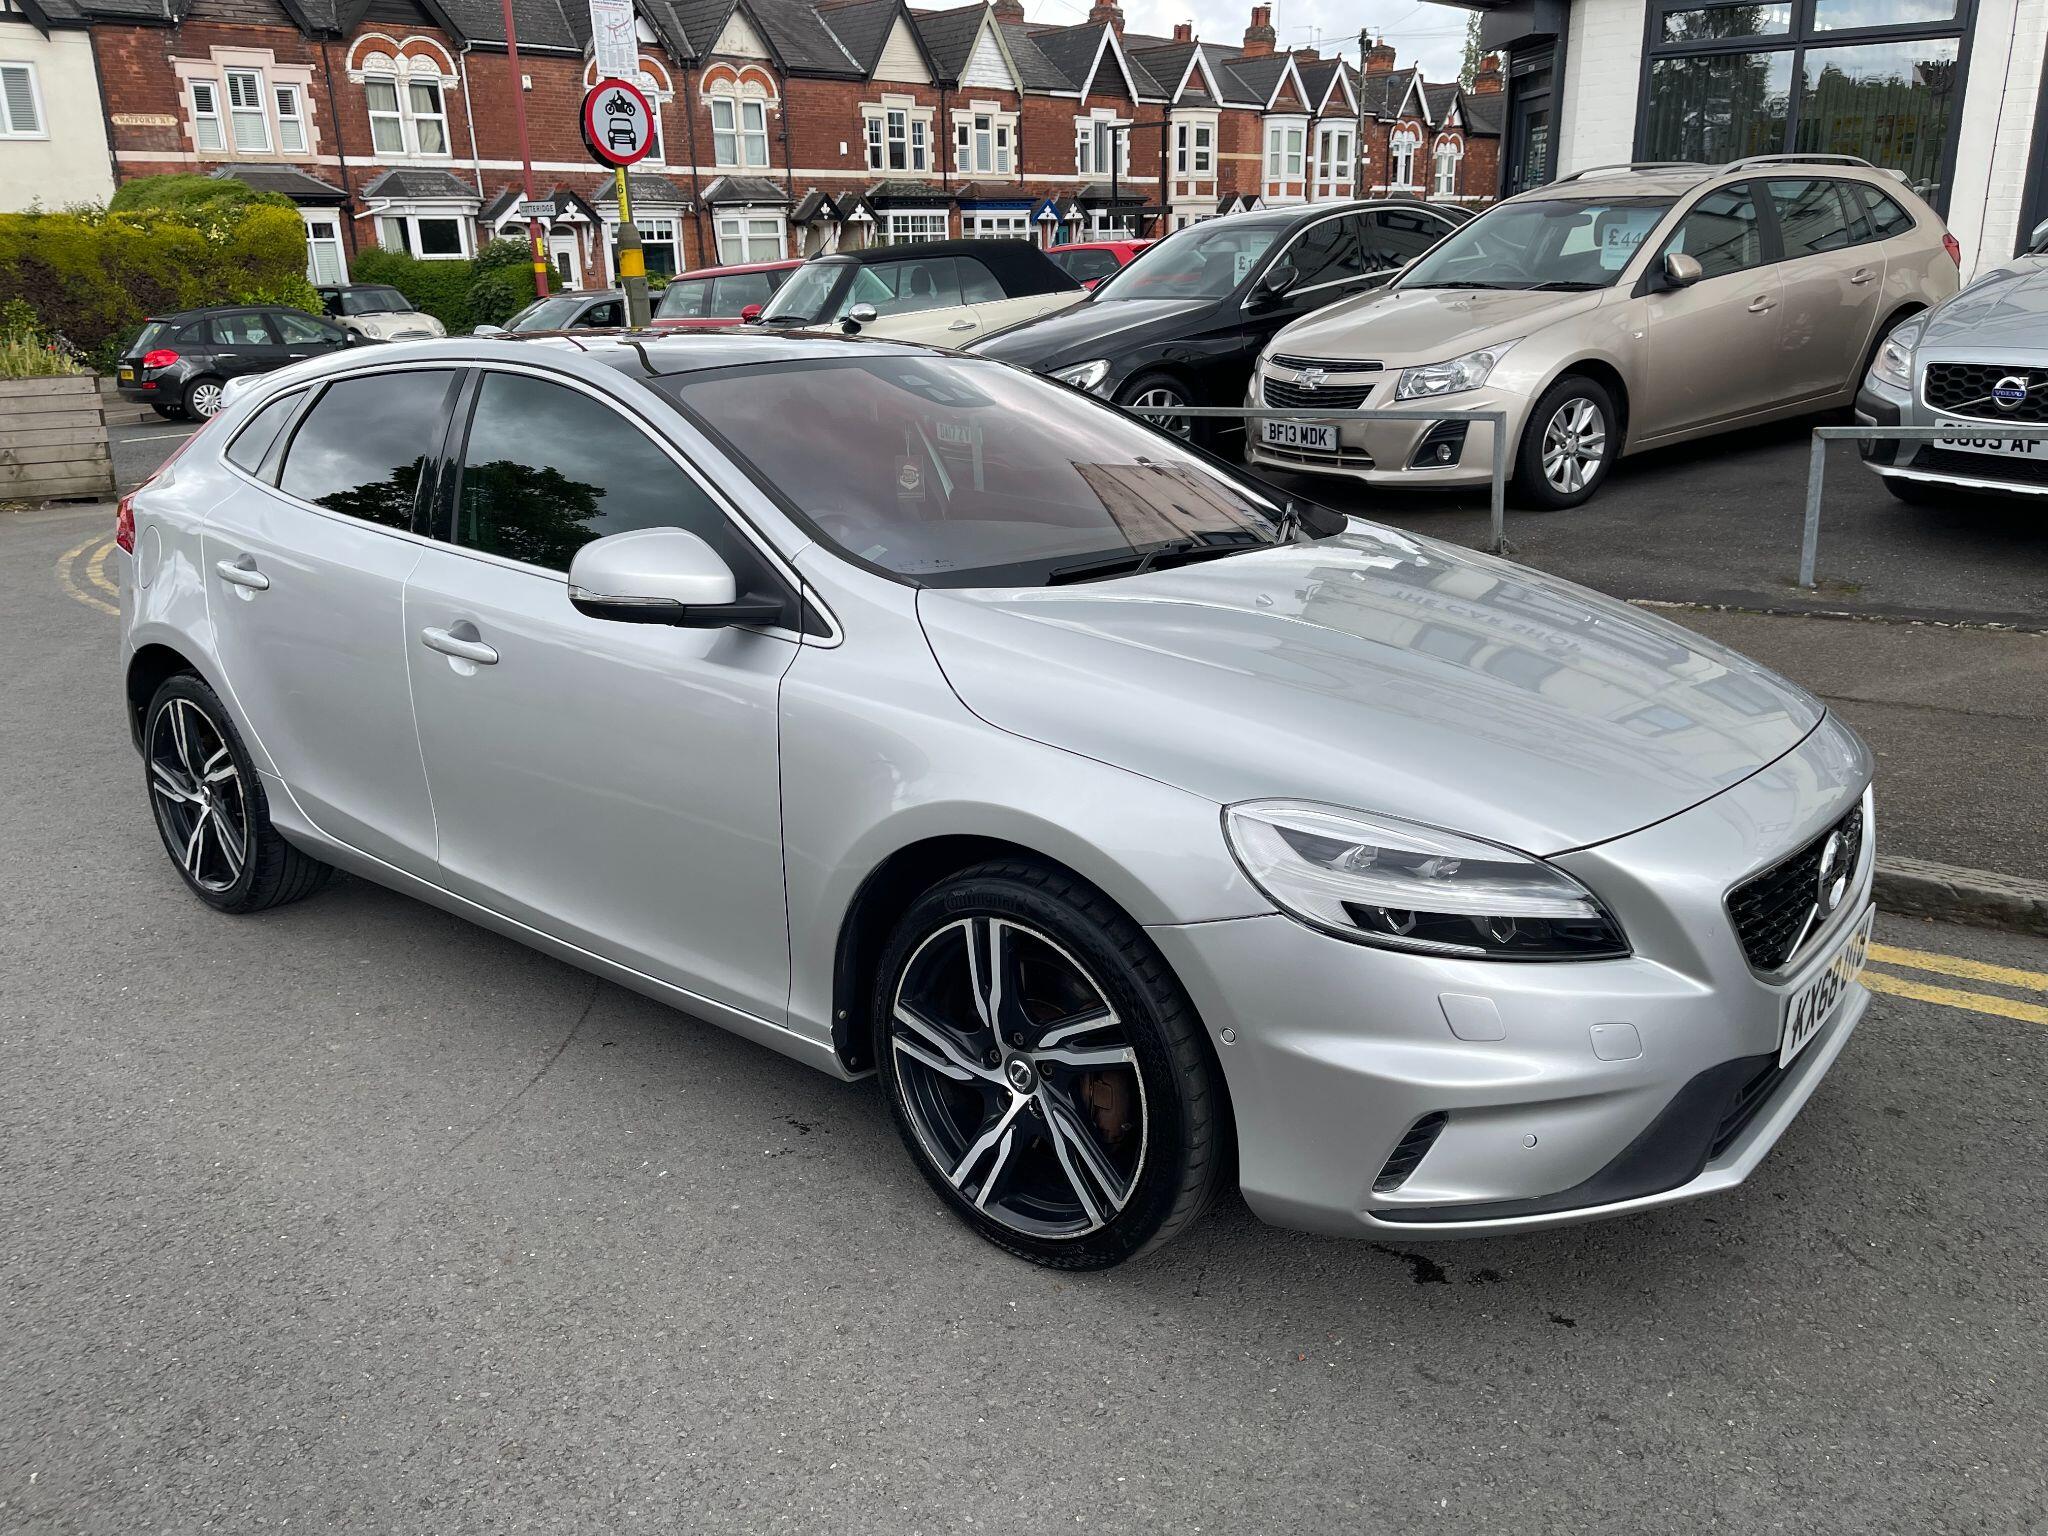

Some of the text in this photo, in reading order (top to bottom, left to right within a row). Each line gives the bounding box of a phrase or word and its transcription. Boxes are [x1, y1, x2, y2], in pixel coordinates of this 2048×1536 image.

[118, 116, 156, 124] WATFORD
[617, 184, 624, 194] 6
[521, 203, 555, 214] COTTERIDGE
[1268, 422, 1328, 446] BF13 MDK
[1790, 955, 1843, 1051] KX68
